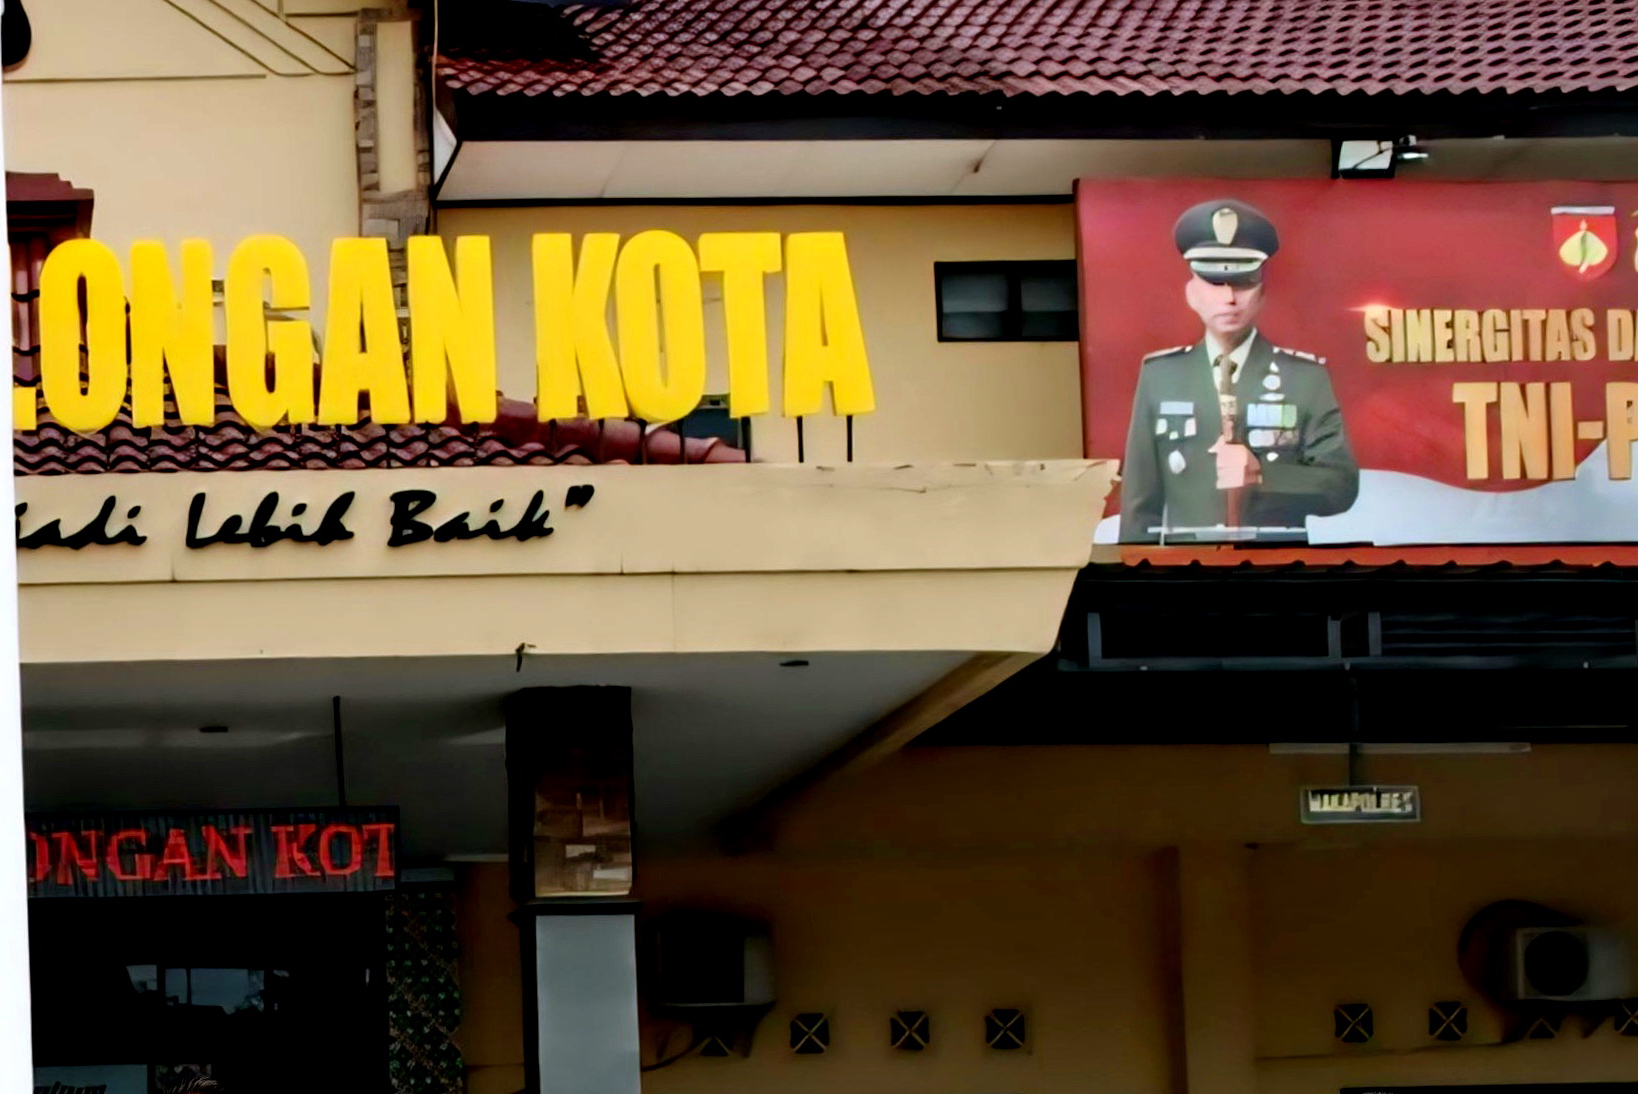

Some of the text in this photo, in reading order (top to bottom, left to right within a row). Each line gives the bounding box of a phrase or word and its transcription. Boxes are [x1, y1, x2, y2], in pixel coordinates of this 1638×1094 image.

[530, 229, 875, 424] KOTA
[1364, 308, 1638, 363] SINERGITAS D
[185, 491, 355, 550] Lebih
